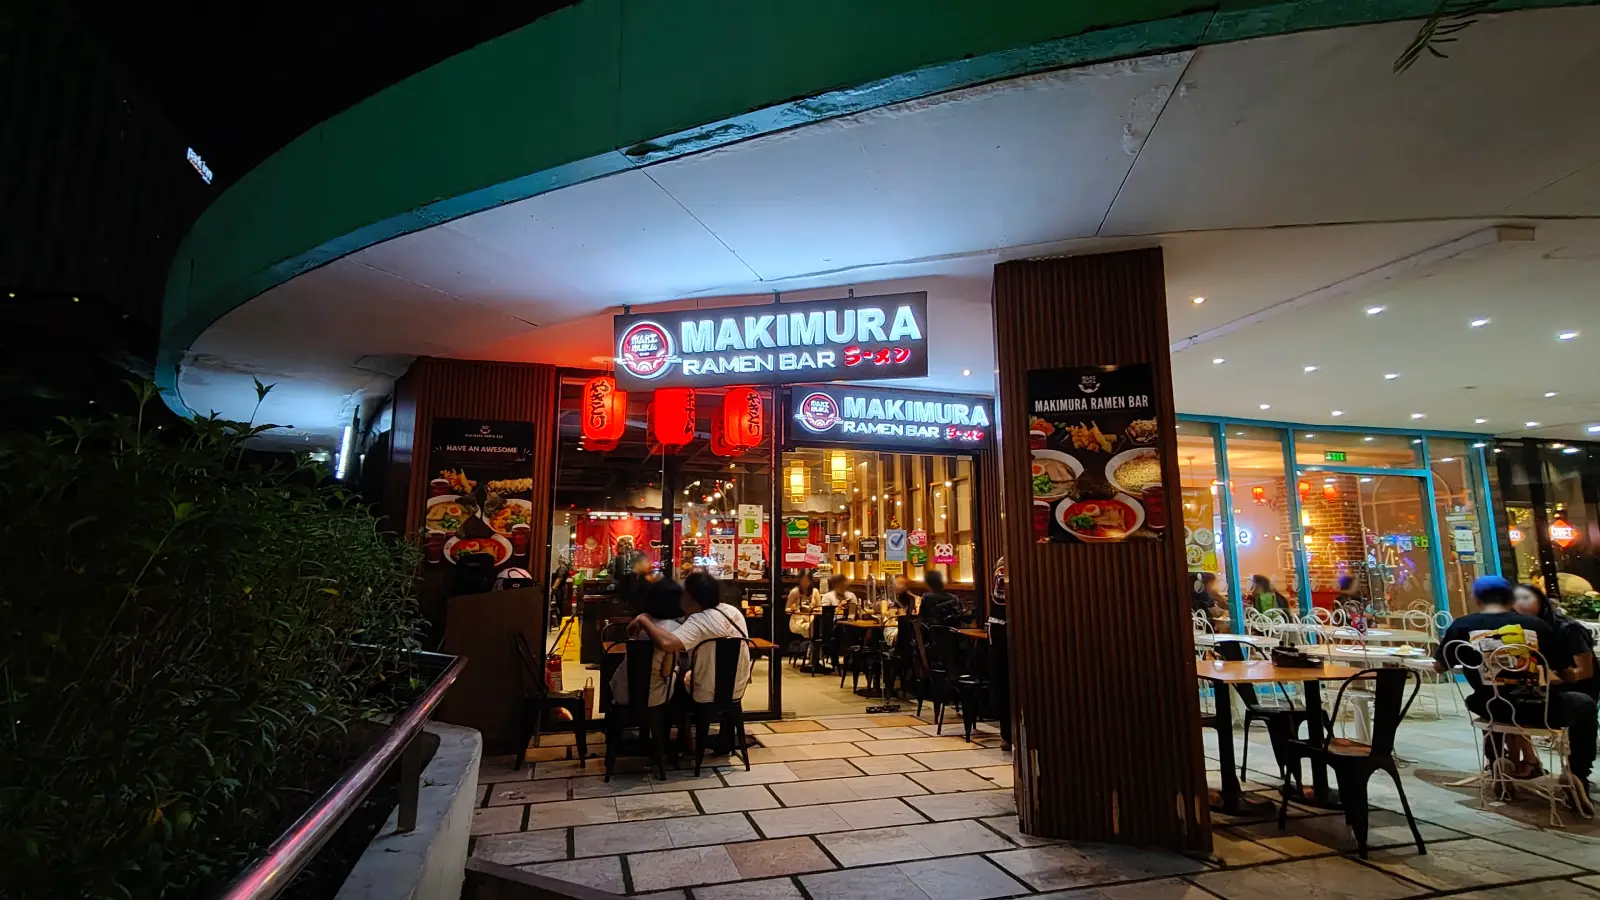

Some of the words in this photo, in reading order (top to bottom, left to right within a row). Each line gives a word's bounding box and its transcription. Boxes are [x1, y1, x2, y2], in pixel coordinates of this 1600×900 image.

[681, 305, 922, 353] MAKIMURA
[682, 354, 774, 375] RAMEN
[779, 350, 836, 371] BAR
[844, 345, 911, 367] ラーメン
[844, 396, 990, 426] MAKIMURA
[1035, 398, 1087, 412] MAKIMURA
[1091, 396, 1125, 410] RAMEN
[1129, 395, 1149, 408] BAR
[843, 420, 903, 435] RAMEN
[905, 425, 940, 438] BAR
[446, 444, 466, 452] HAVE
[1326, 451, 1343, 460] EXIT
